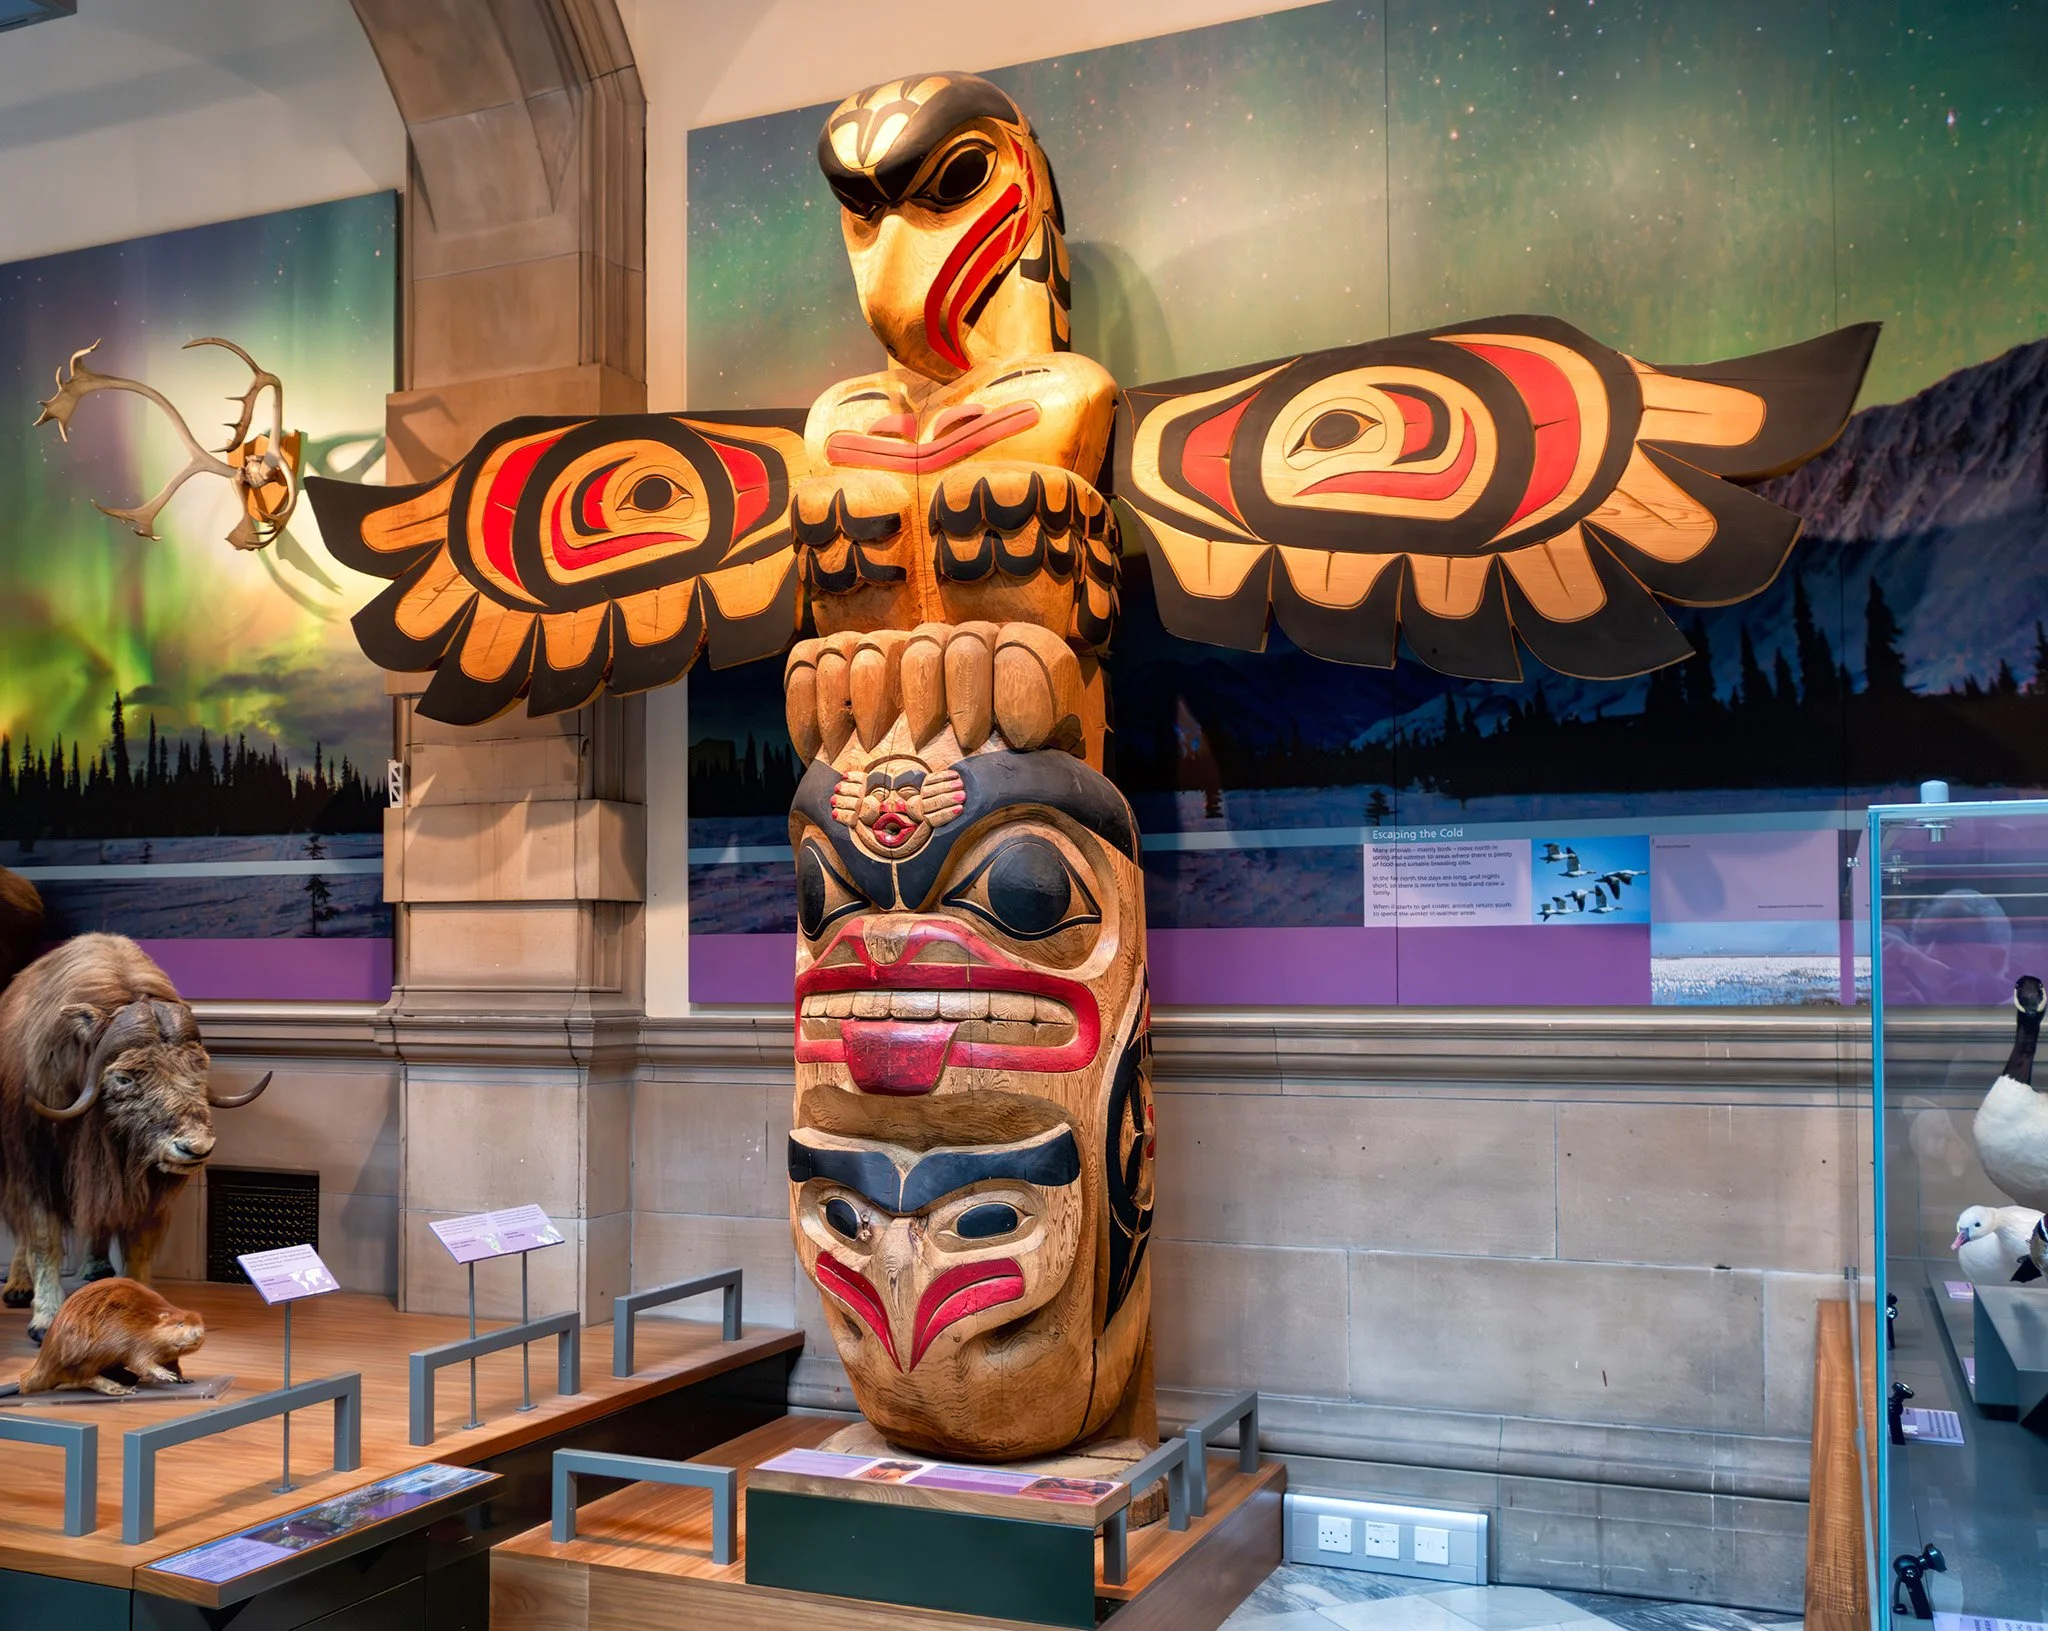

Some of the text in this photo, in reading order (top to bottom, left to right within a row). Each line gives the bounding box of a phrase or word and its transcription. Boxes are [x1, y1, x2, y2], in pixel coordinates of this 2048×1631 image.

[1373, 828, 1463, 841] Escaping the Cold
